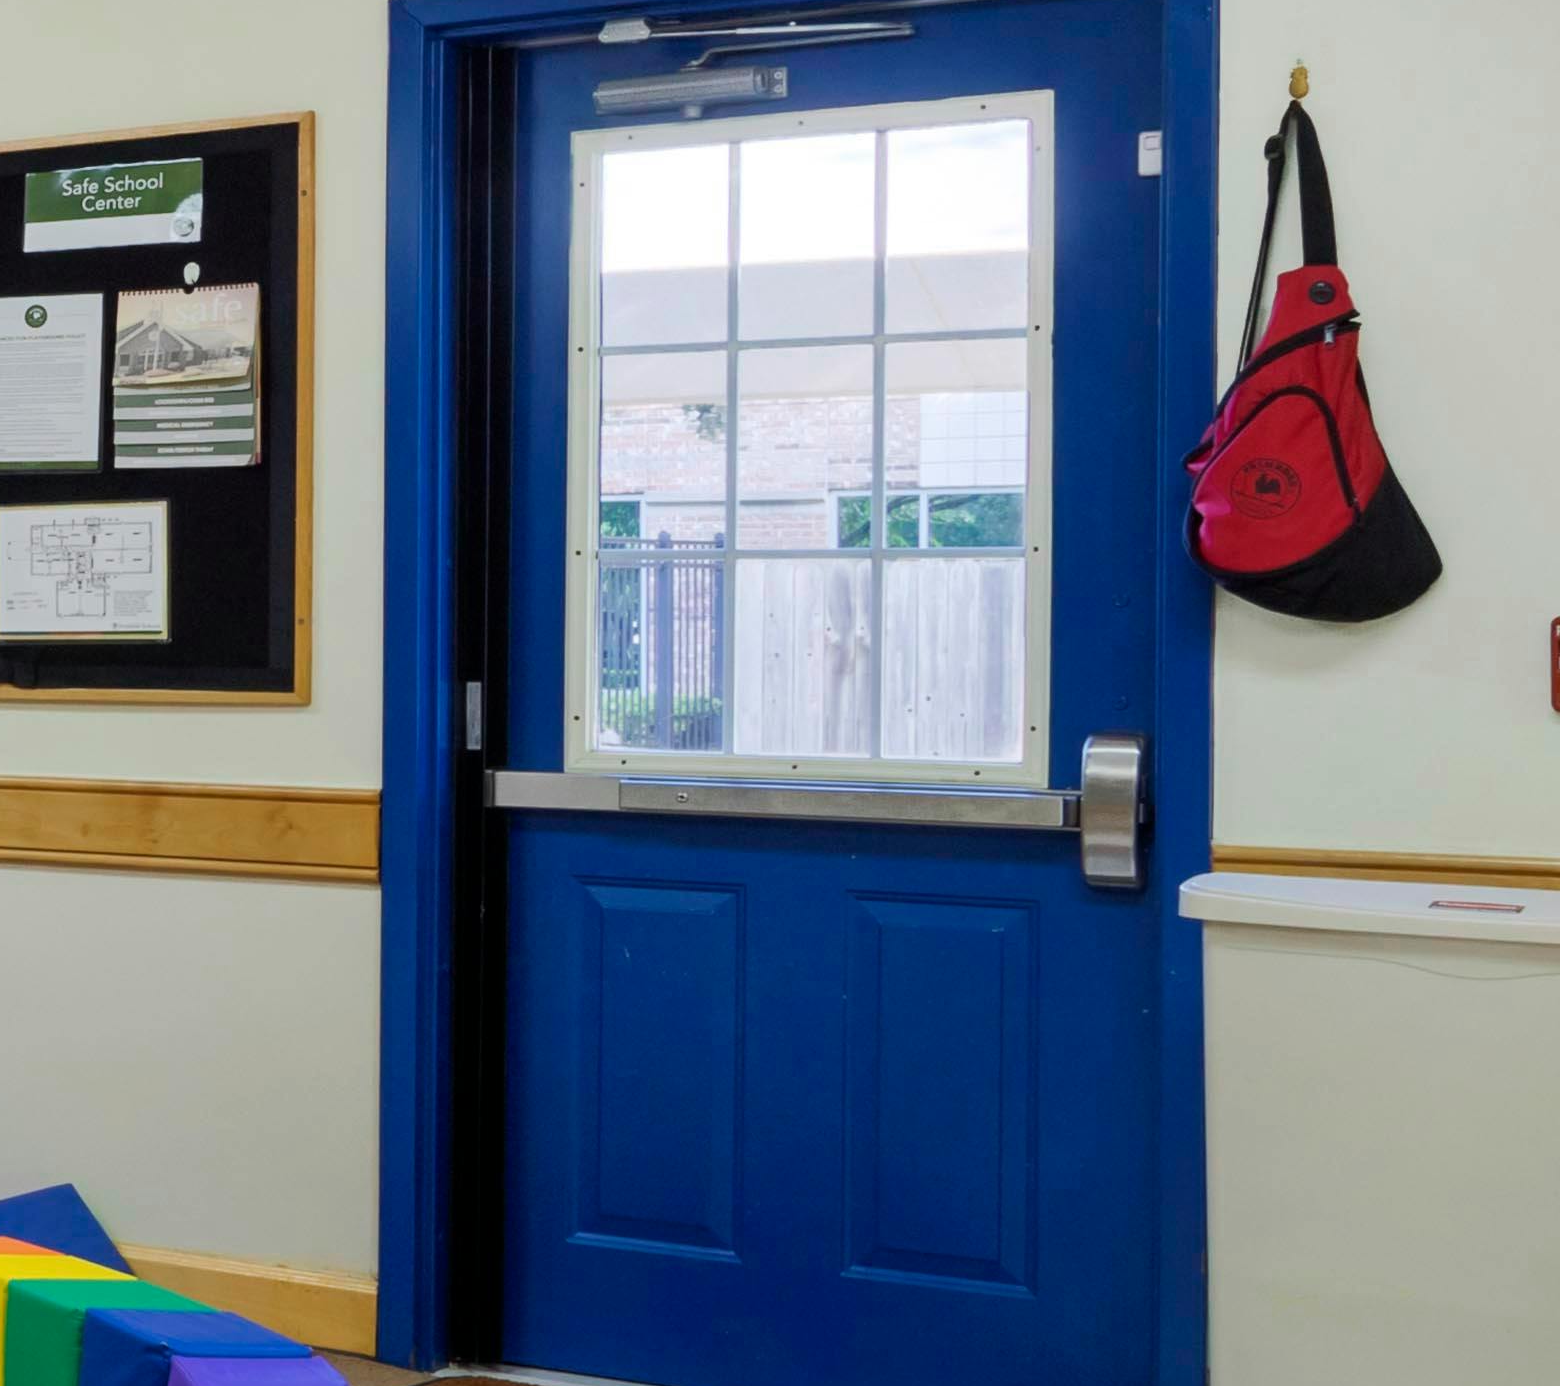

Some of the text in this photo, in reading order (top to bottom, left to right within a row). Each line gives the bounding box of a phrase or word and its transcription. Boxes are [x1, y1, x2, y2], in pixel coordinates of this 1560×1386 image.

[62, 172, 163, 196] Safe School
[81, 196, 141, 212] Center
